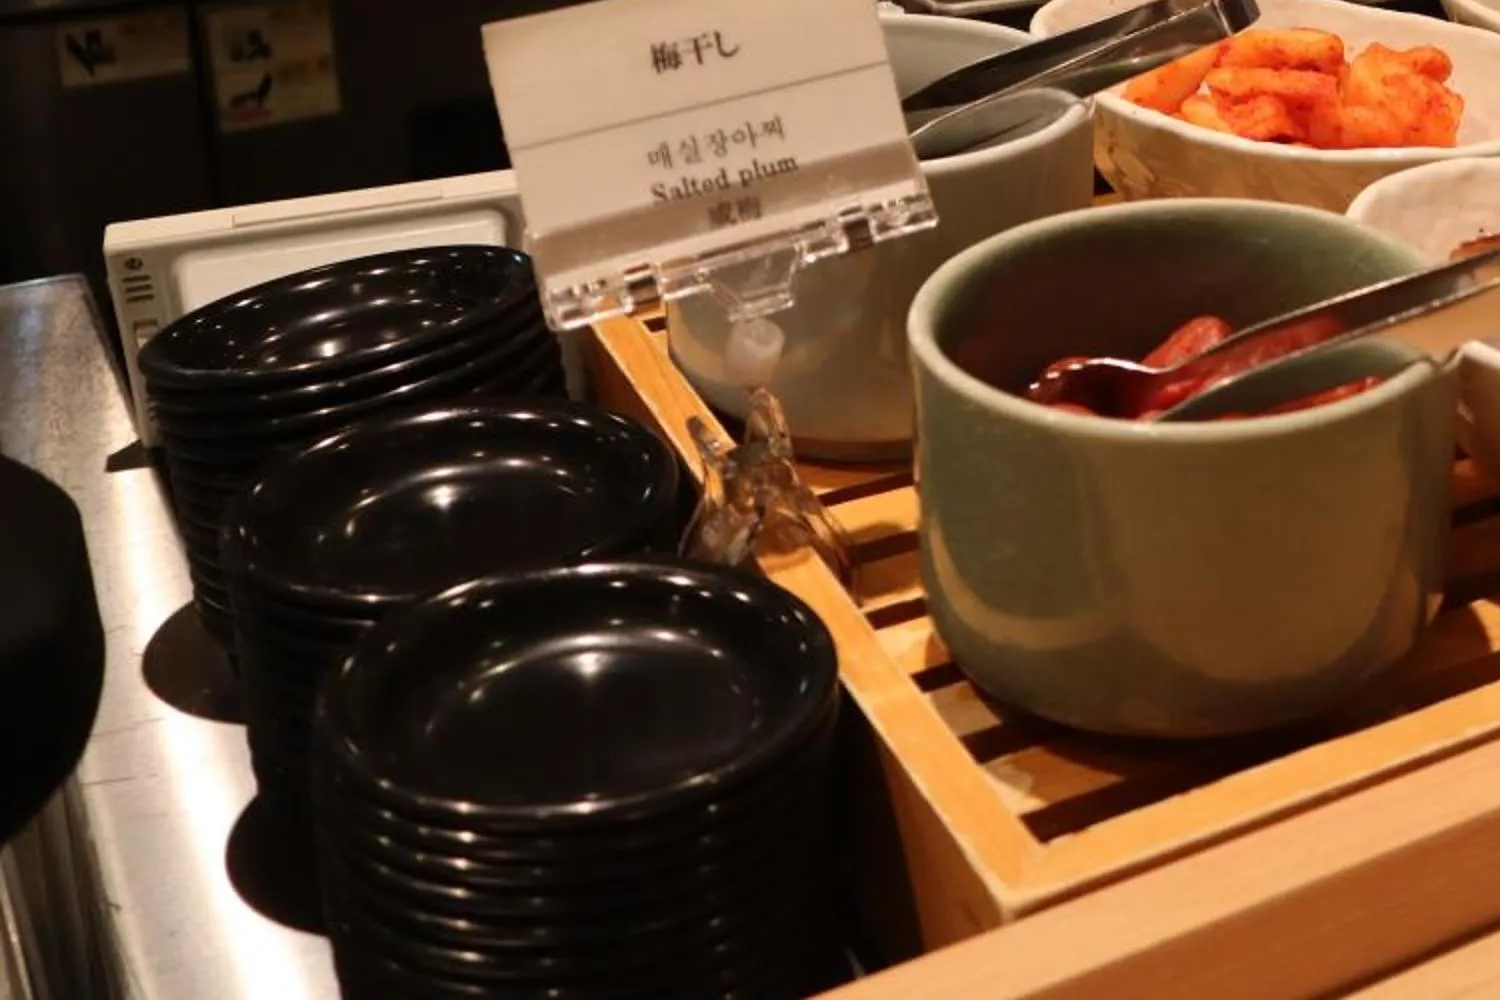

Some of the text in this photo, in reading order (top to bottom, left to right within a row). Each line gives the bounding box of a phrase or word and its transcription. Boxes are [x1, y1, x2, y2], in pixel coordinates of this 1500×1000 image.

[650, 30, 741, 74] 梅干し
[651, 156, 799, 201] Salted plum
